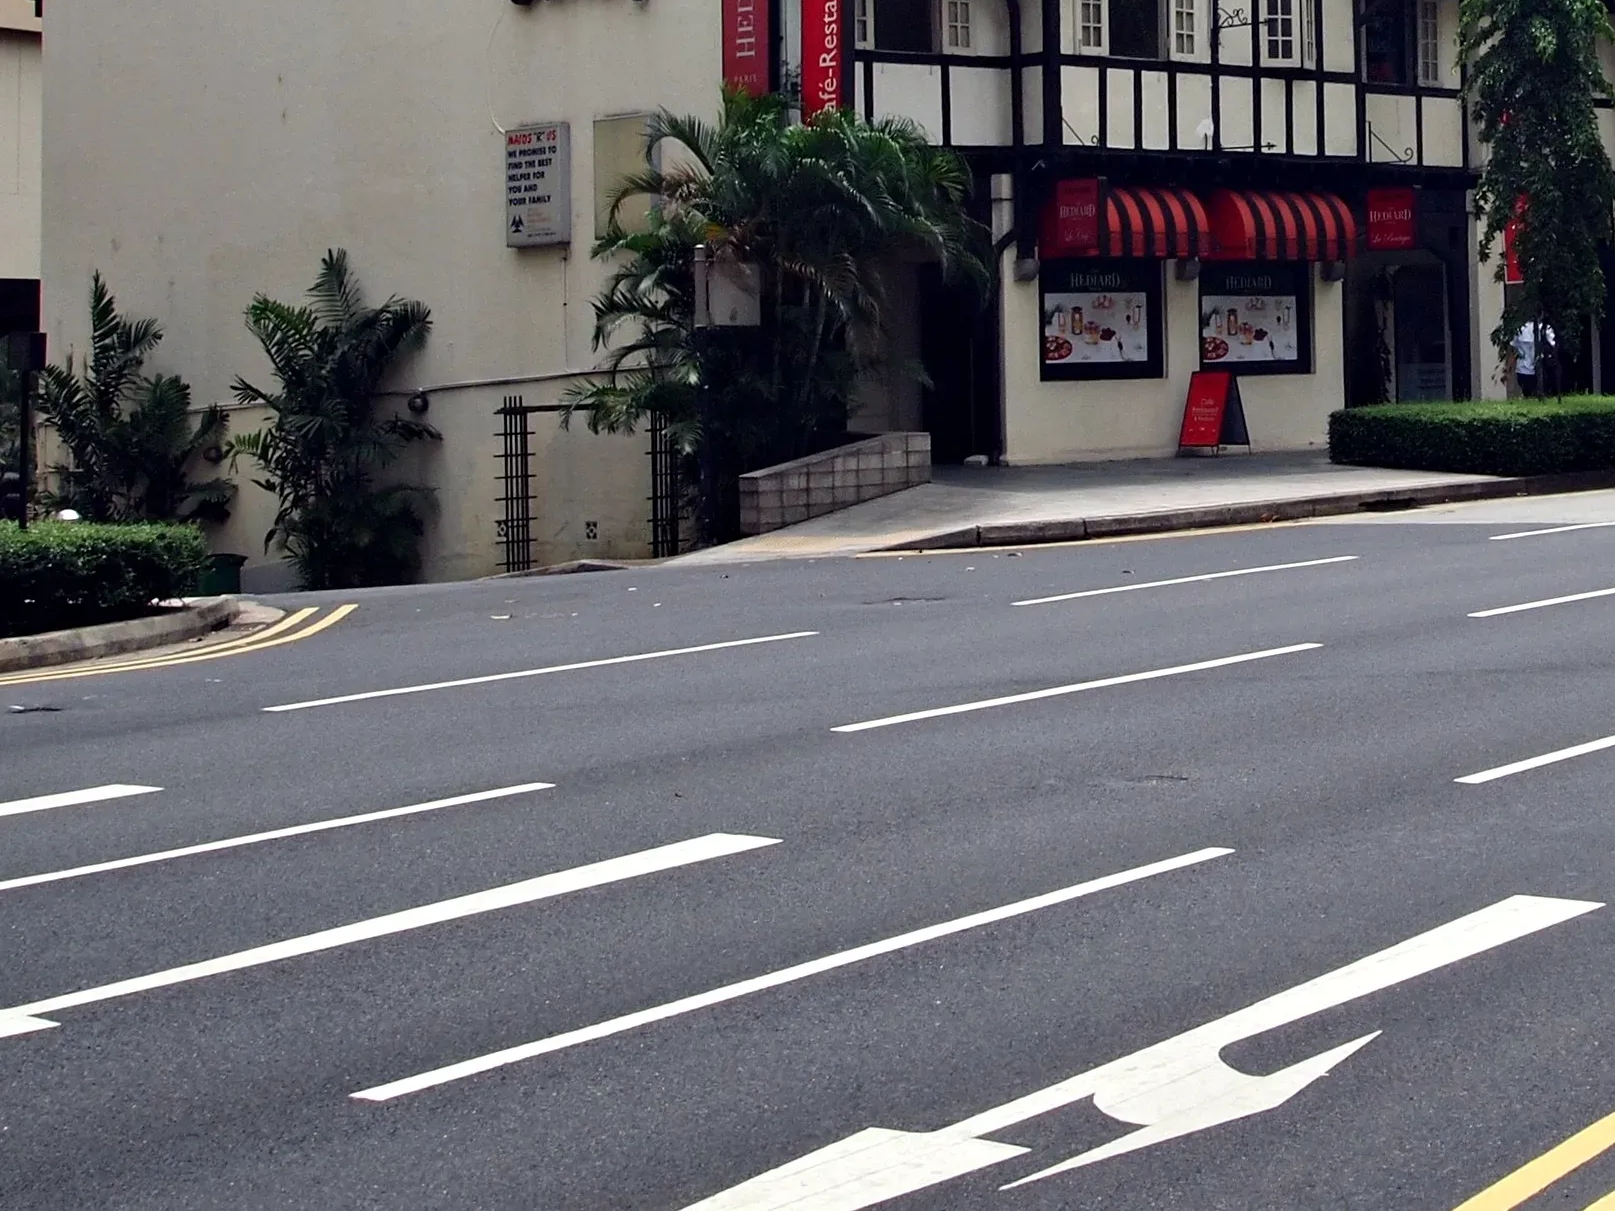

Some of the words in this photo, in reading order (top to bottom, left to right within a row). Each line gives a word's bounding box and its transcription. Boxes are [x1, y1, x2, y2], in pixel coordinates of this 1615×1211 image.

[508, 133, 532, 145] MAIDS
[546, 130, 556, 141] US
[508, 150, 517, 158] WE
[519, 147, 546, 157] PROMISE
[548, 146, 557, 154] TO
[508, 162, 522, 170] FIND
[525, 160, 536, 169] THE
[538, 158, 552, 167] BEST
[508, 173, 531, 182] HELPER
[533, 171, 545, 179] FOR
[509, 186, 522, 194] YOU
[524, 184, 537, 192] AND
[509, 197, 526, 206] YOUR
[529, 195, 551, 204] FAMILY
[1060, 204, 1096, 218] HEDIARD
[1370, 209, 1411, 222] HEDIARD
[1071, 273, 1120, 287] HEDIARD
[1226, 276, 1272, 289] HEDIARD
